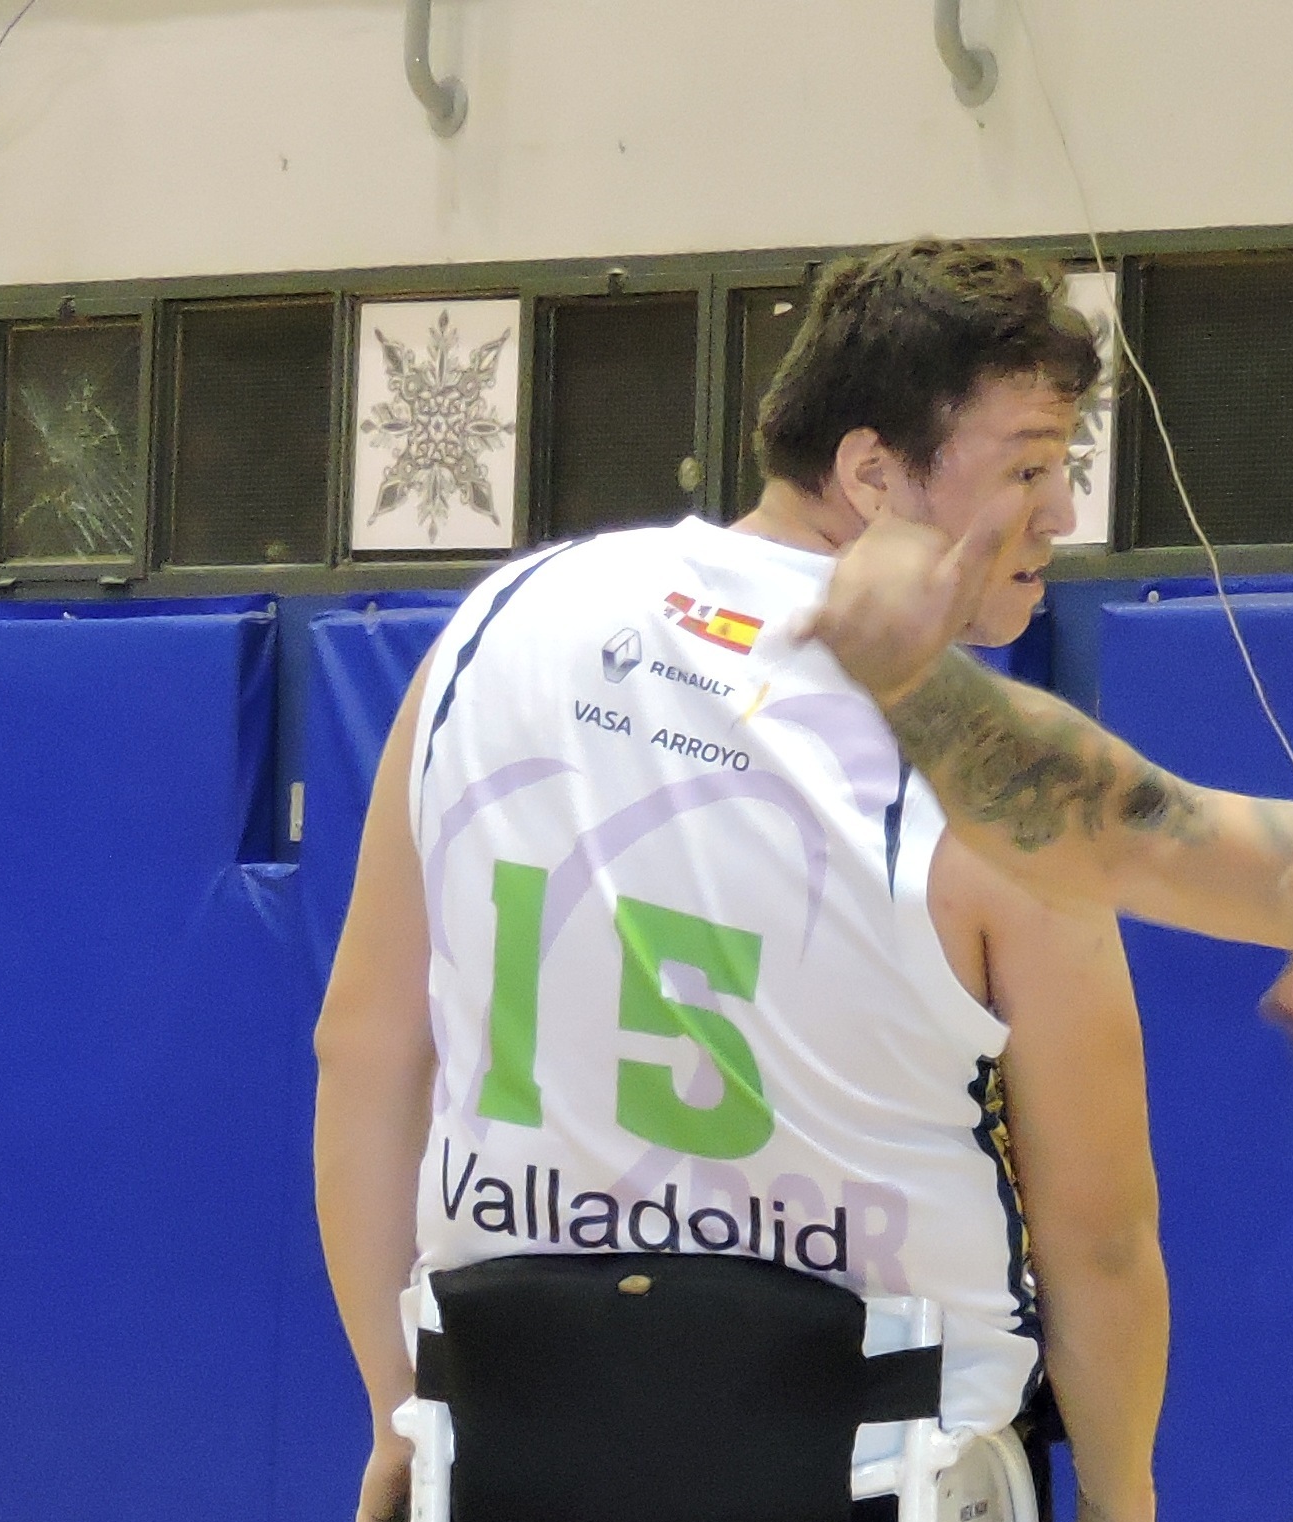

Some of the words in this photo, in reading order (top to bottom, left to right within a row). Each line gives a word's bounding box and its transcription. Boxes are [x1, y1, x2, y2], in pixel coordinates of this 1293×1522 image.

[650, 660, 735, 697] RENAULT
[575, 700, 631, 736] VASA
[651, 728, 750, 772] ARROYO
[476, 859, 775, 1160] 15
[441, 1137, 849, 1272] Valladolid
